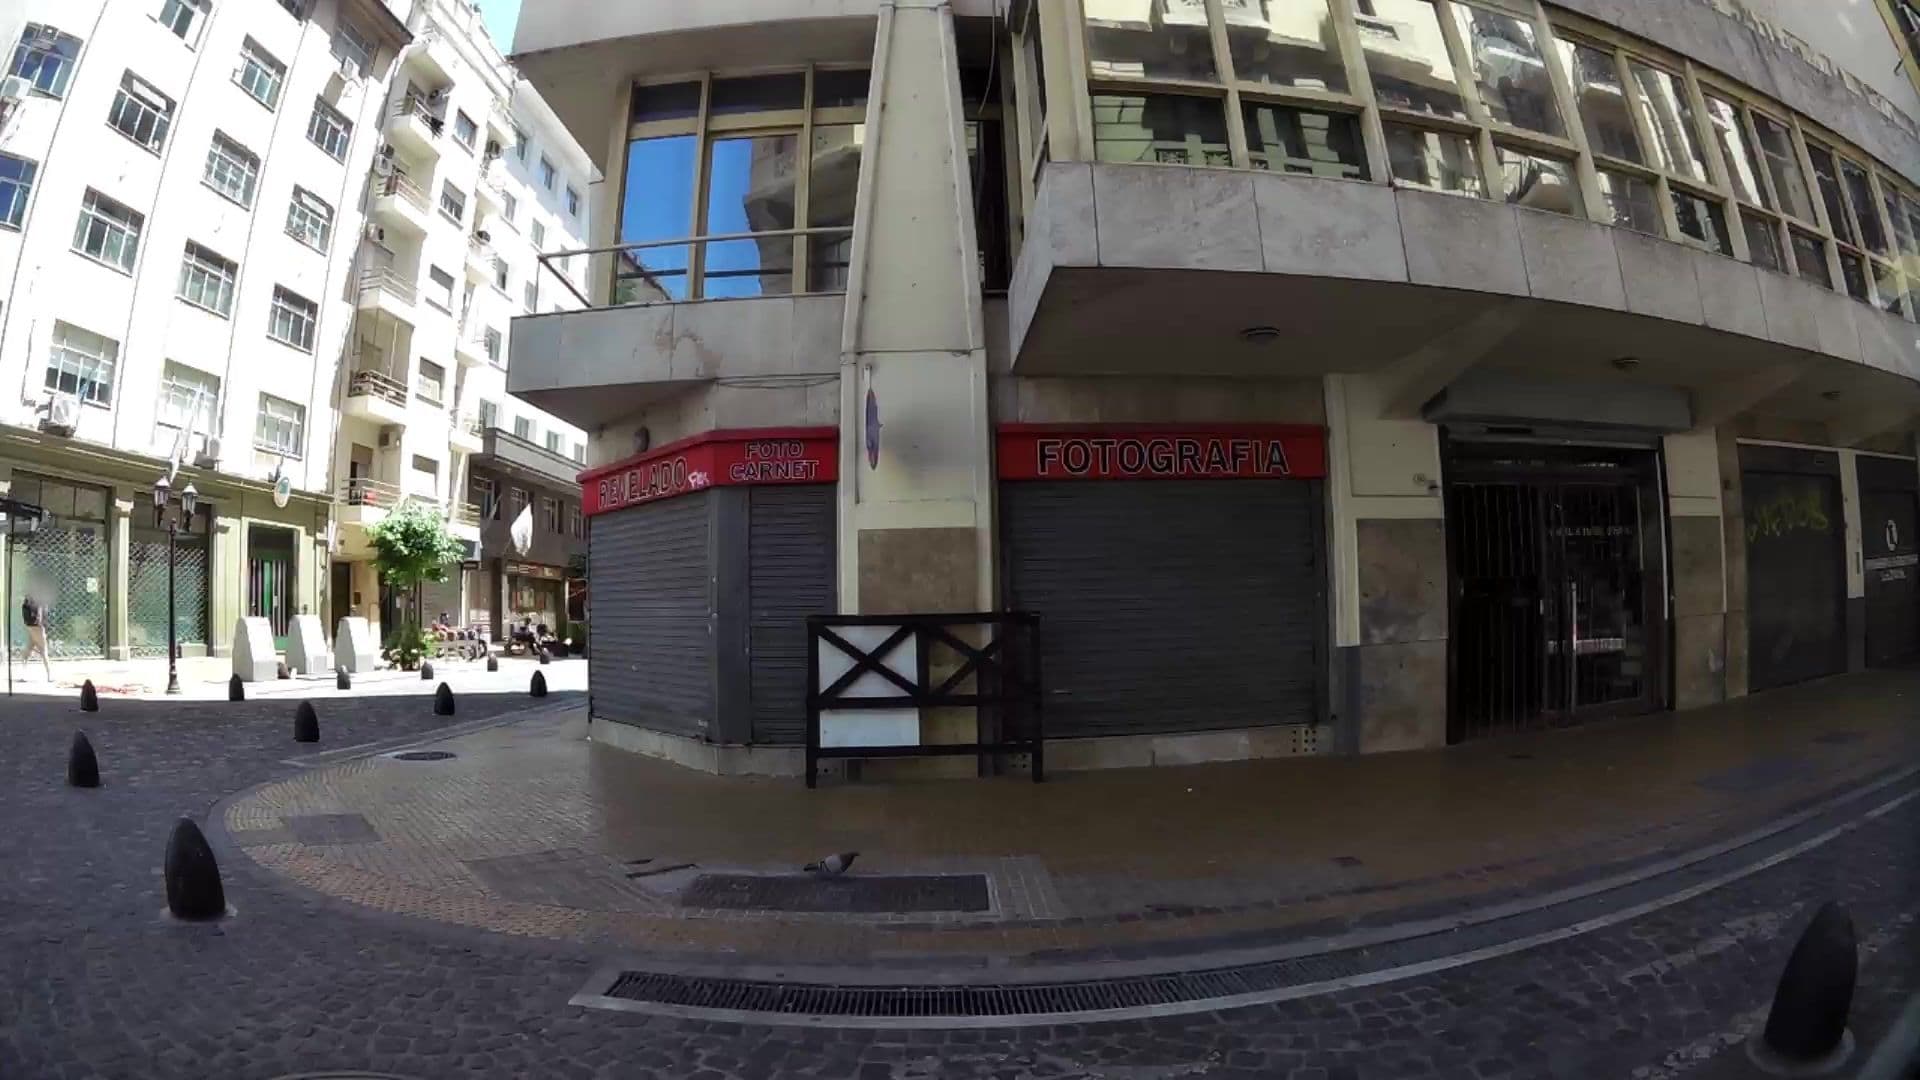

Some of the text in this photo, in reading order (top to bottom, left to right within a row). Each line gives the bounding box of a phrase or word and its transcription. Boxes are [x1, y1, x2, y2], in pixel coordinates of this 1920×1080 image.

[745, 440, 804, 459] FOTO
[1037, 439, 1290, 474] FOTOGRAFIA
[598, 456, 688, 510] REVELADO
[730, 459, 819, 482] CARNET
